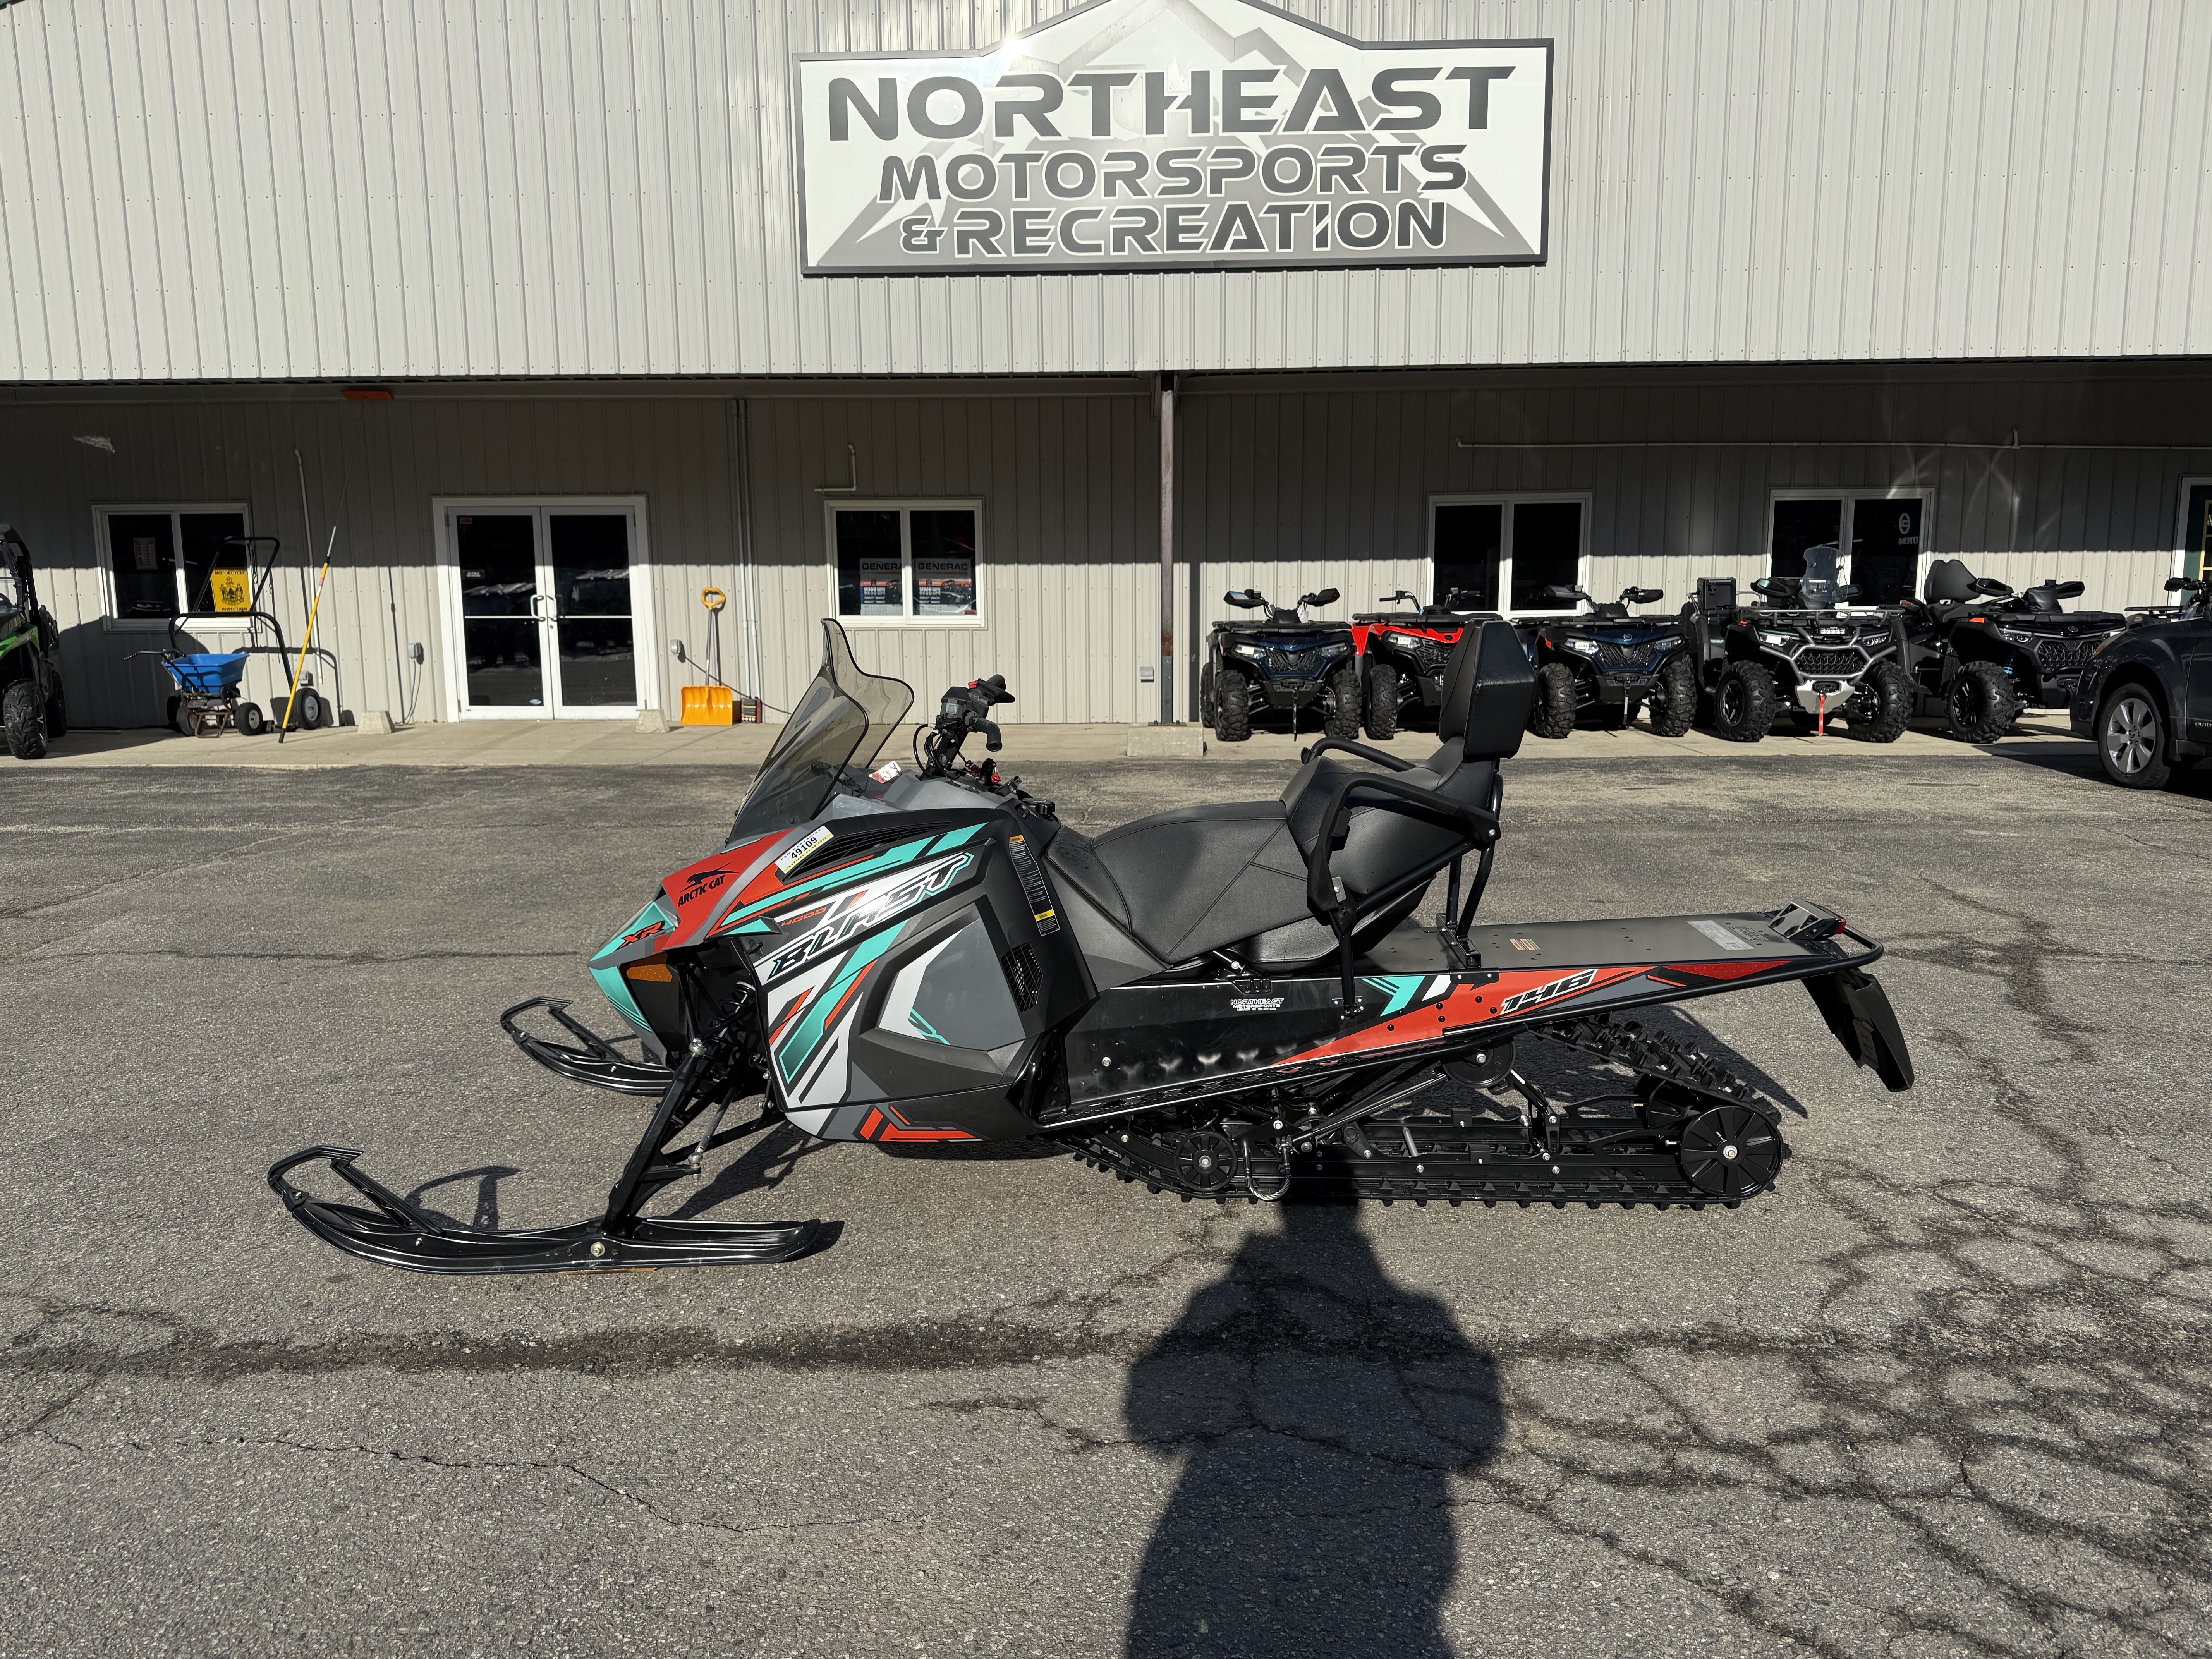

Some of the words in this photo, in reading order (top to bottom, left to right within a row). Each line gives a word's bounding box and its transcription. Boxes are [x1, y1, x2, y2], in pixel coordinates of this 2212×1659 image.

[828, 65, 1516, 143] NORTHEAST
[878, 143, 1468, 202] MOTORSPORTS
[792, 837, 817, 859] 49109
[678, 883, 708, 907] ARCTIC
[709, 874, 726, 890] CAT
[615, 920, 666, 951] XR
[766, 854, 969, 981] BLAST
[1500, 968, 1599, 1015] 146
